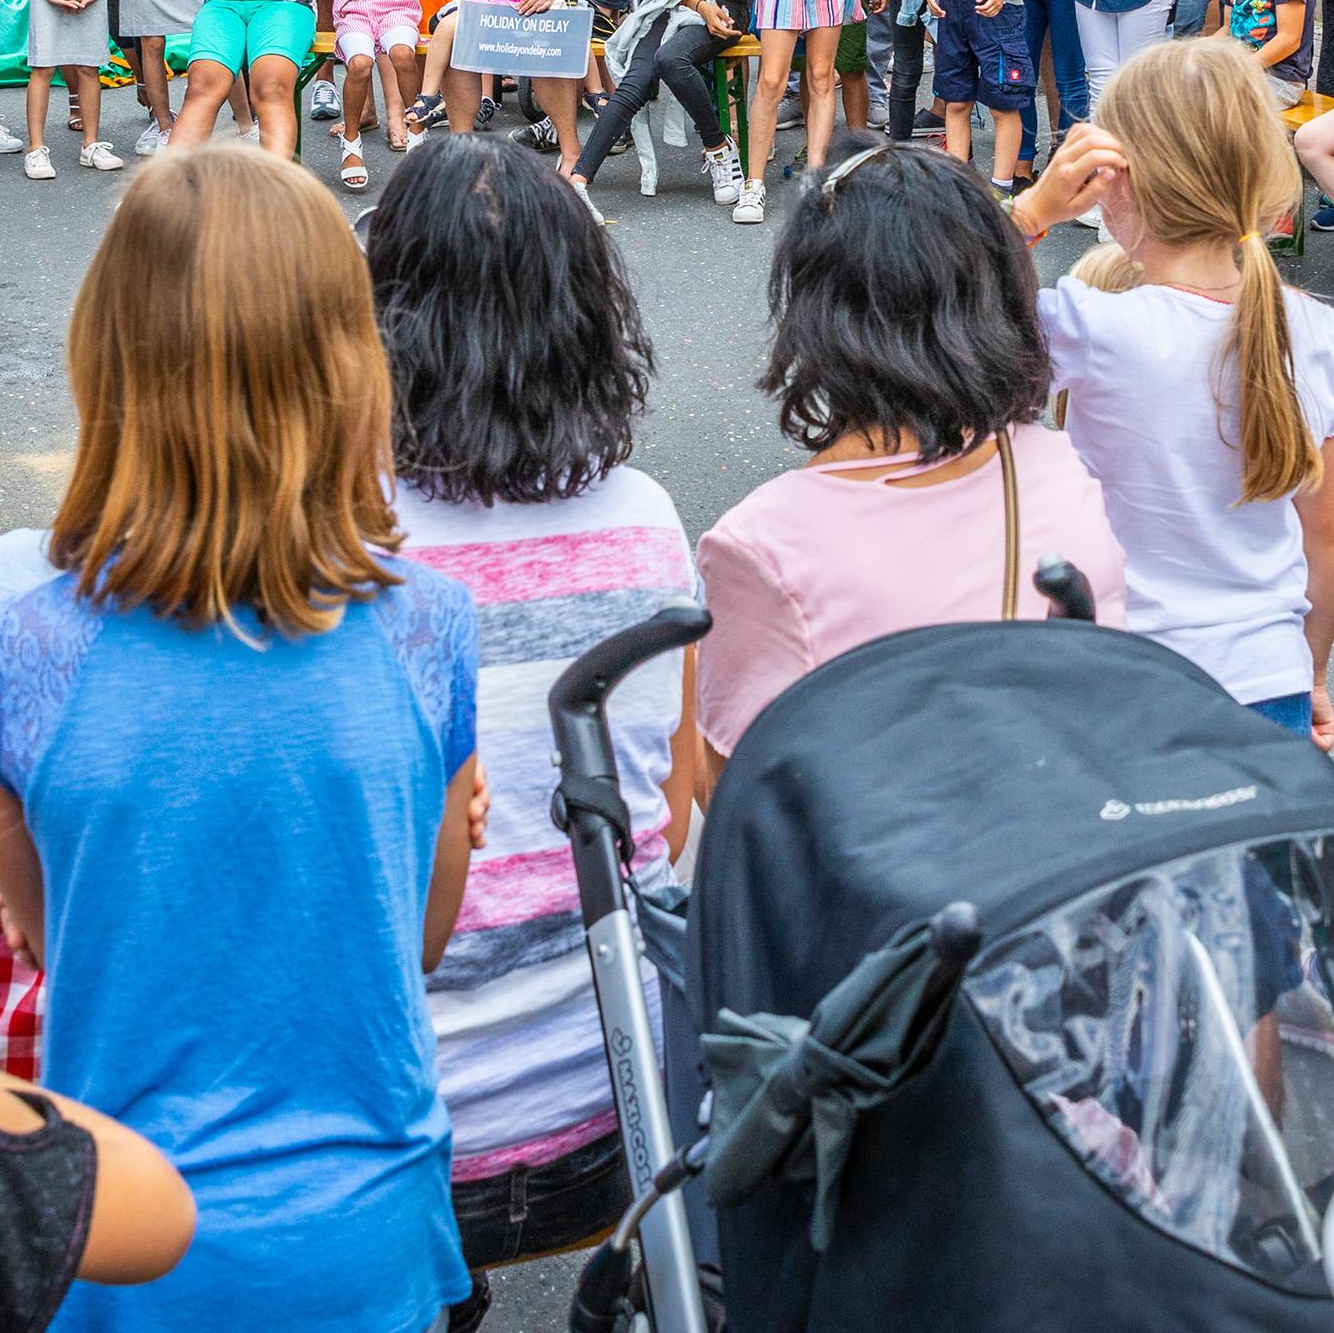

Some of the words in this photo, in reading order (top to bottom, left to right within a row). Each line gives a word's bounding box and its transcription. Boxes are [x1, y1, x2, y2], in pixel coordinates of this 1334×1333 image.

[480, 13, 520, 31] HOLIDAY
[523, 18, 537, 32] ON
[539, 19, 570, 34] DELAY
[478, 41, 562, 59] www.holidayondelay.com
